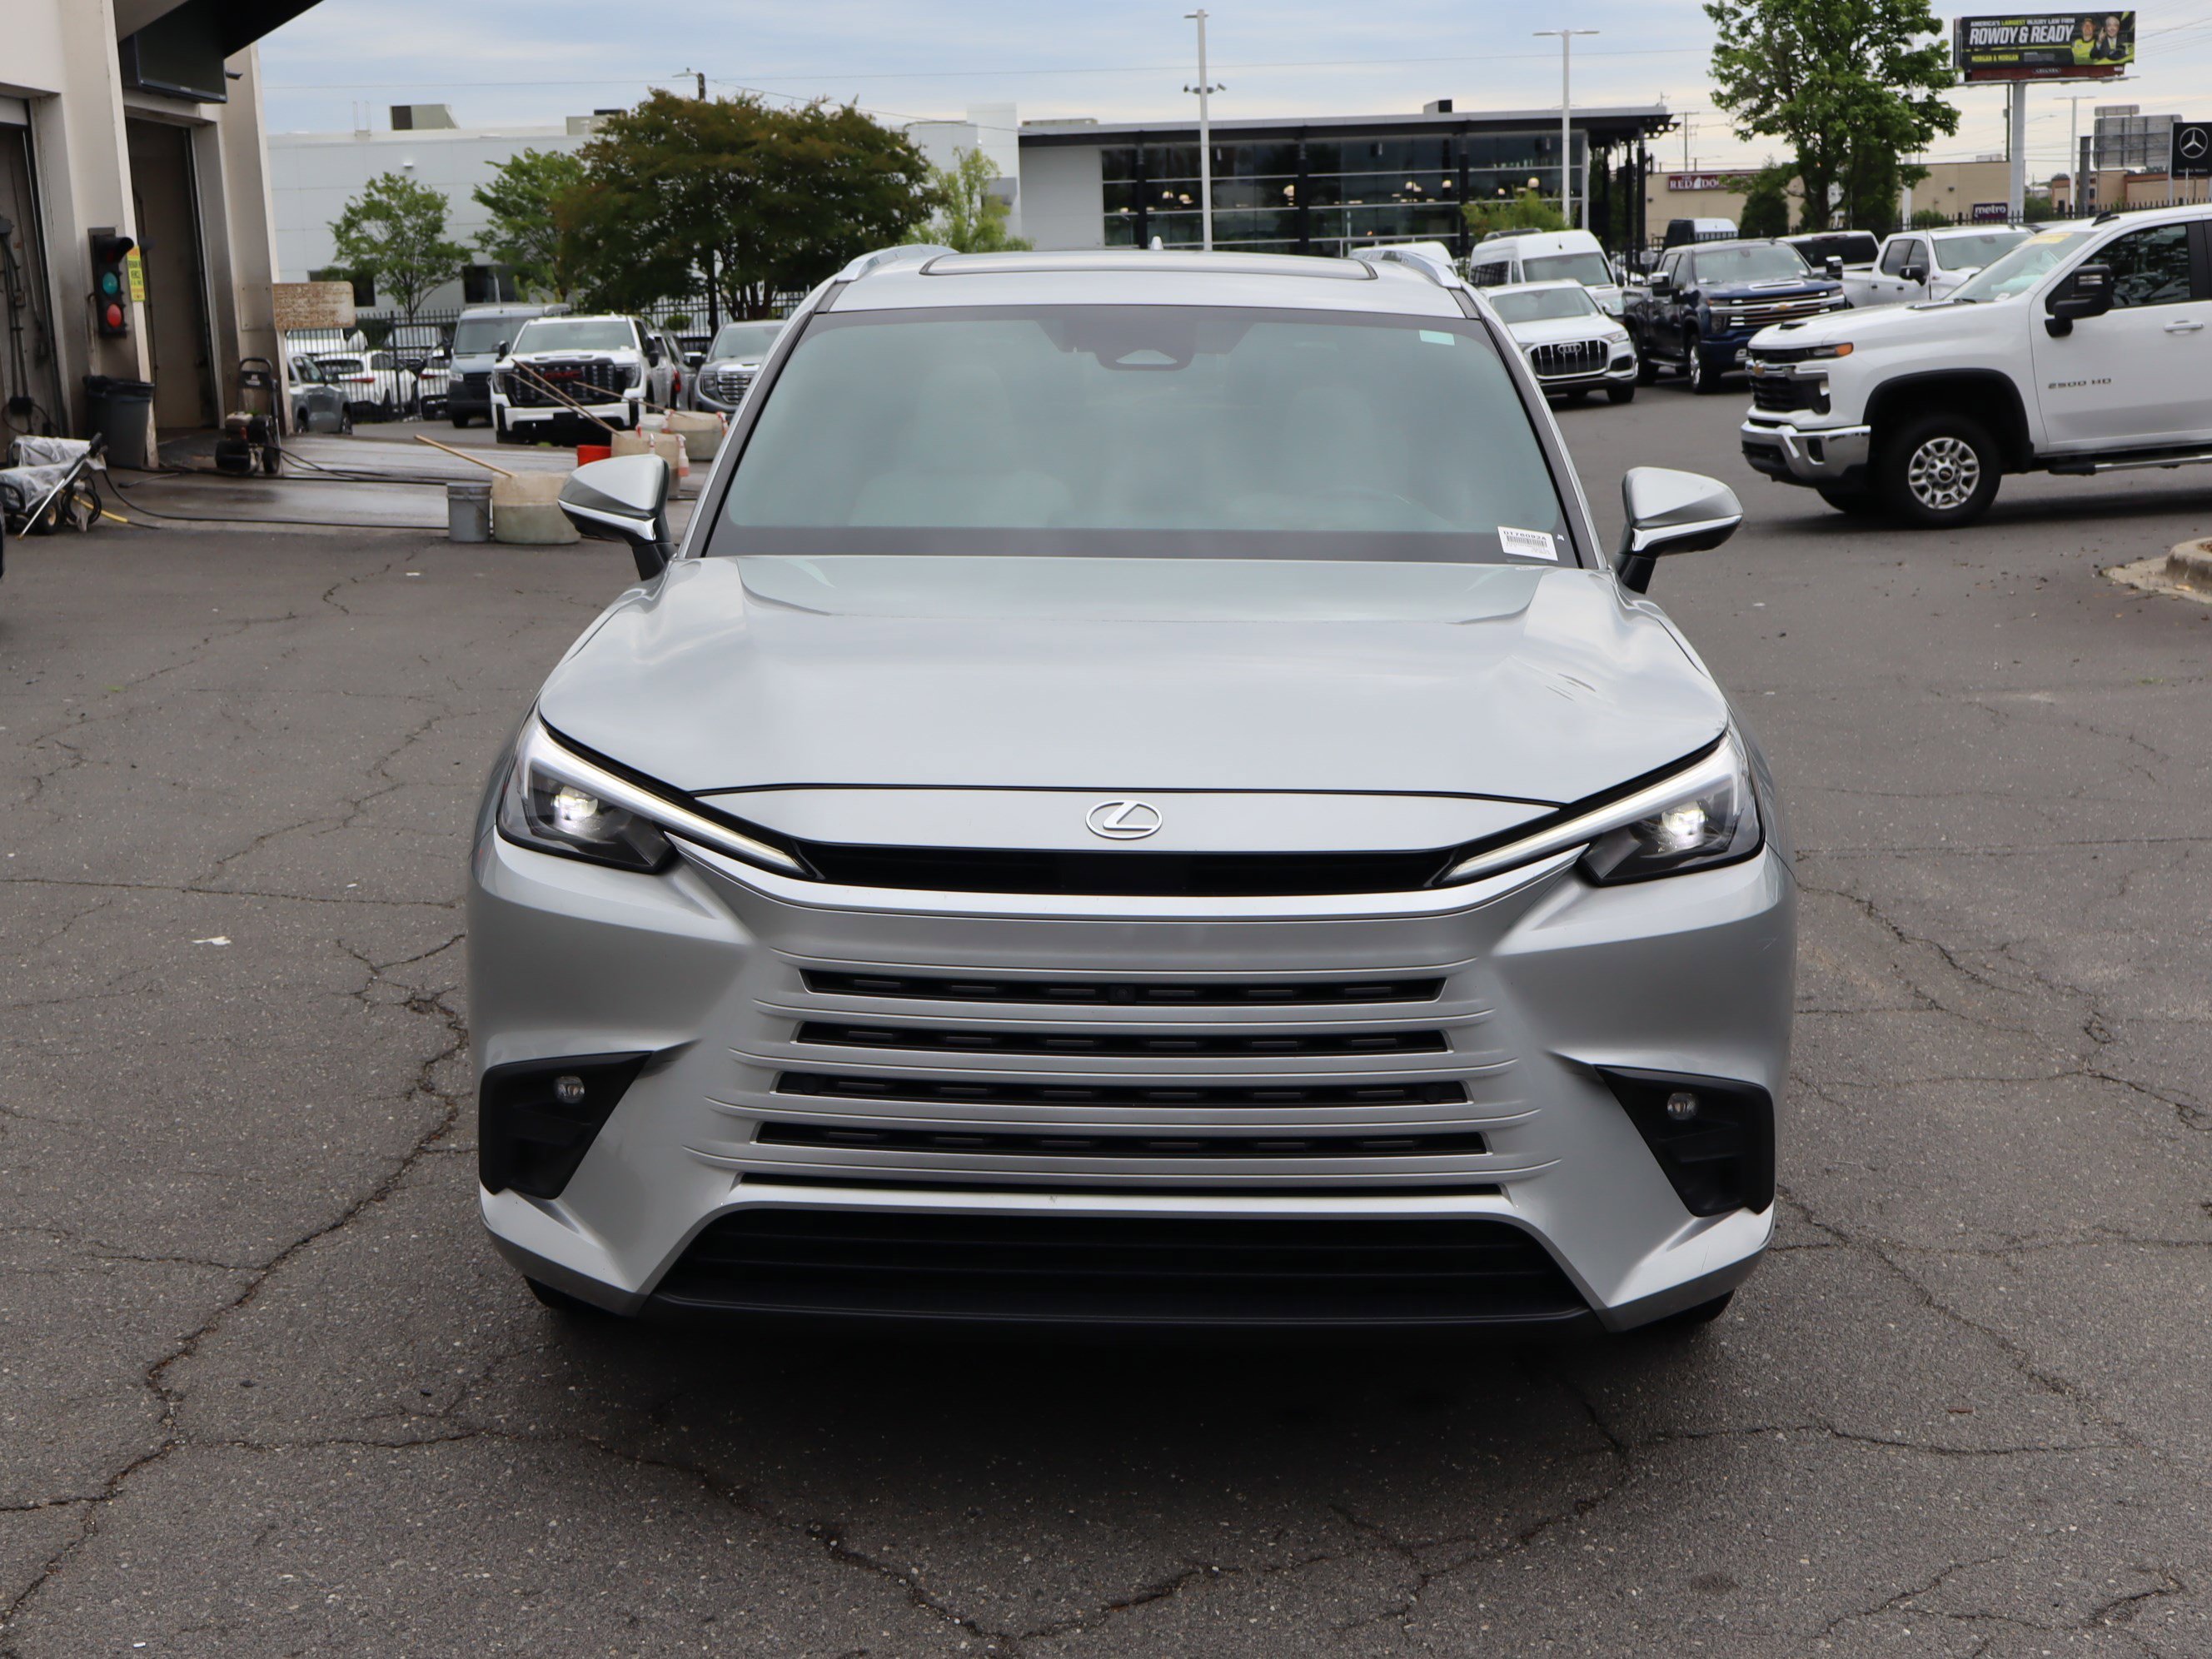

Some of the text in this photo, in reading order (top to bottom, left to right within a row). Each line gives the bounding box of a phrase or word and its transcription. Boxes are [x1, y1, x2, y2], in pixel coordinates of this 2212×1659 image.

[1970, 25, 2075, 45] ROWDY & READY
[1670, 179, 1692, 189] RED
[1975, 205, 2006, 216] metro
[2048, 381, 2086, 389] 2500
